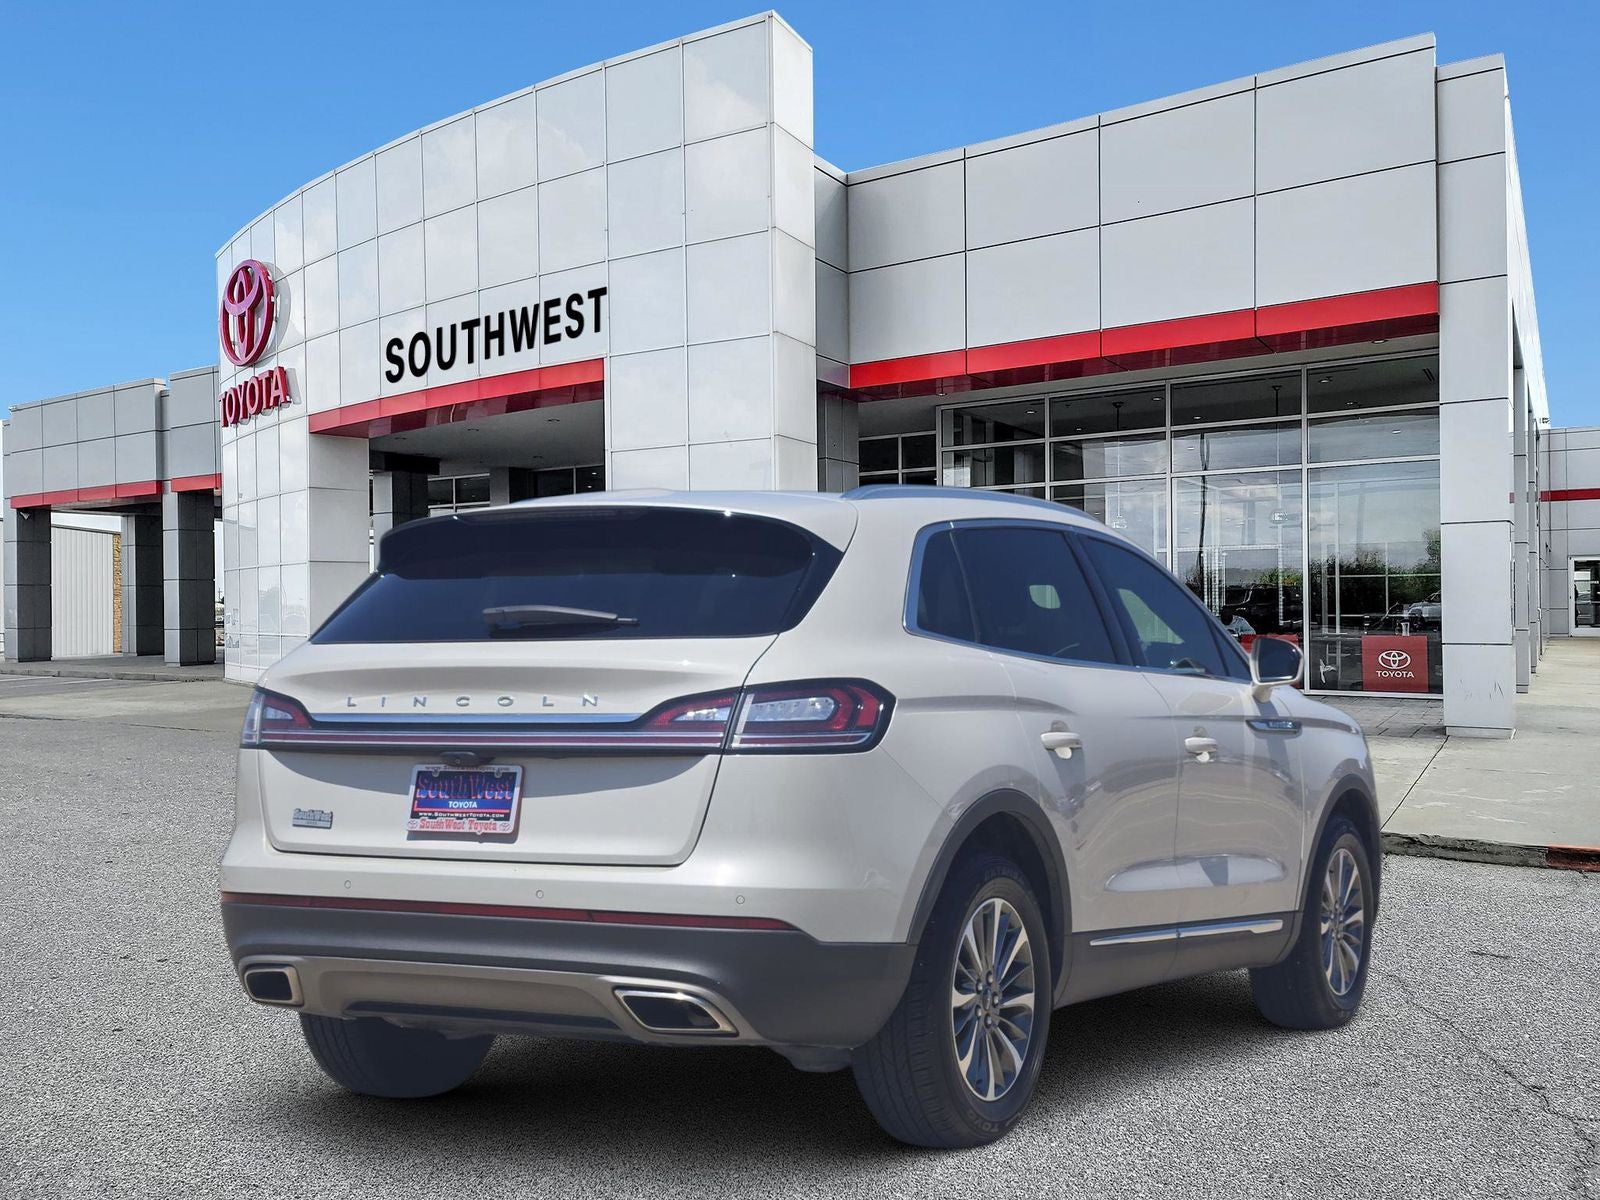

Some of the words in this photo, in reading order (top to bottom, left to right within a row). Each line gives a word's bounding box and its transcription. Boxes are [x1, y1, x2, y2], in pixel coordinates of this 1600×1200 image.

[385, 287, 608, 384] SOUTHWEST
[218, 365, 291, 429] TOYOTA
[1376, 670, 1414, 678] TOYOTA
[346, 694, 598, 708] LINCOLN
[448, 801, 478, 809] TOYOTA
[419, 817, 464, 829] SouthWest
[468, 818, 497, 831] Toyota
